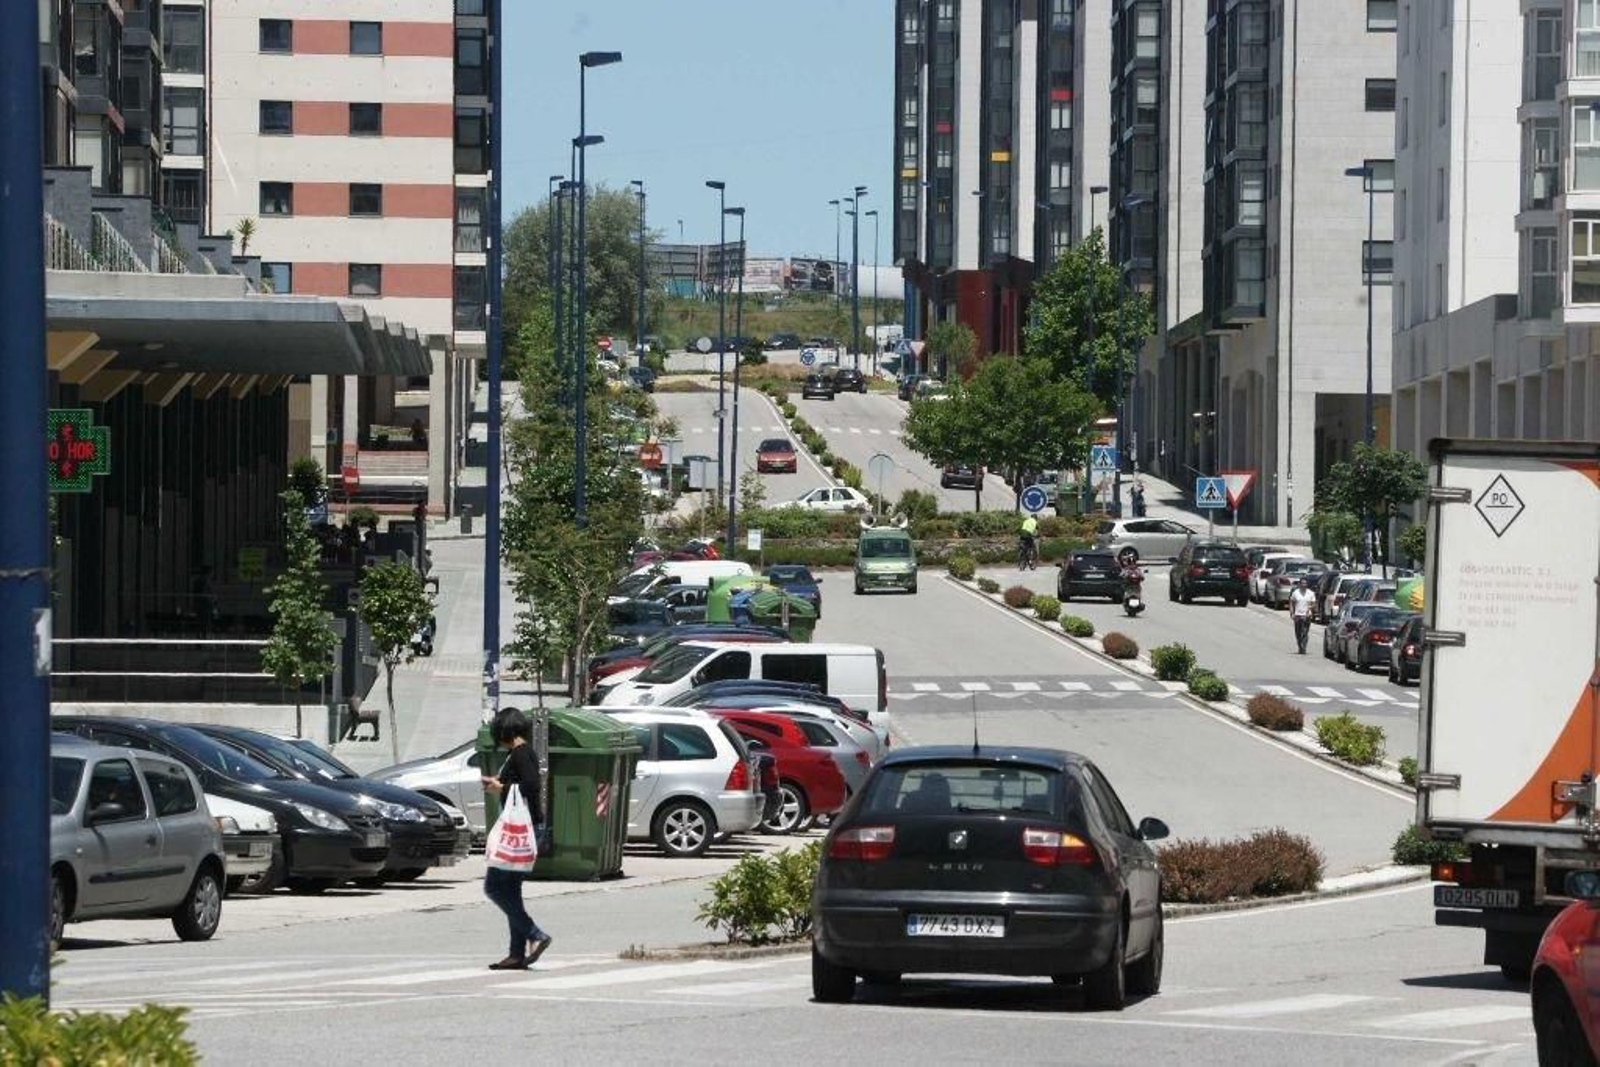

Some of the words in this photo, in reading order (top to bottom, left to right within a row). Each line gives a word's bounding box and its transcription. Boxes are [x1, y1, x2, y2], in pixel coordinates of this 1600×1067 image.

[1492, 493, 1508, 505] PO
[919, 915, 959, 933] 7743
[964, 917, 996, 934] DXZ
